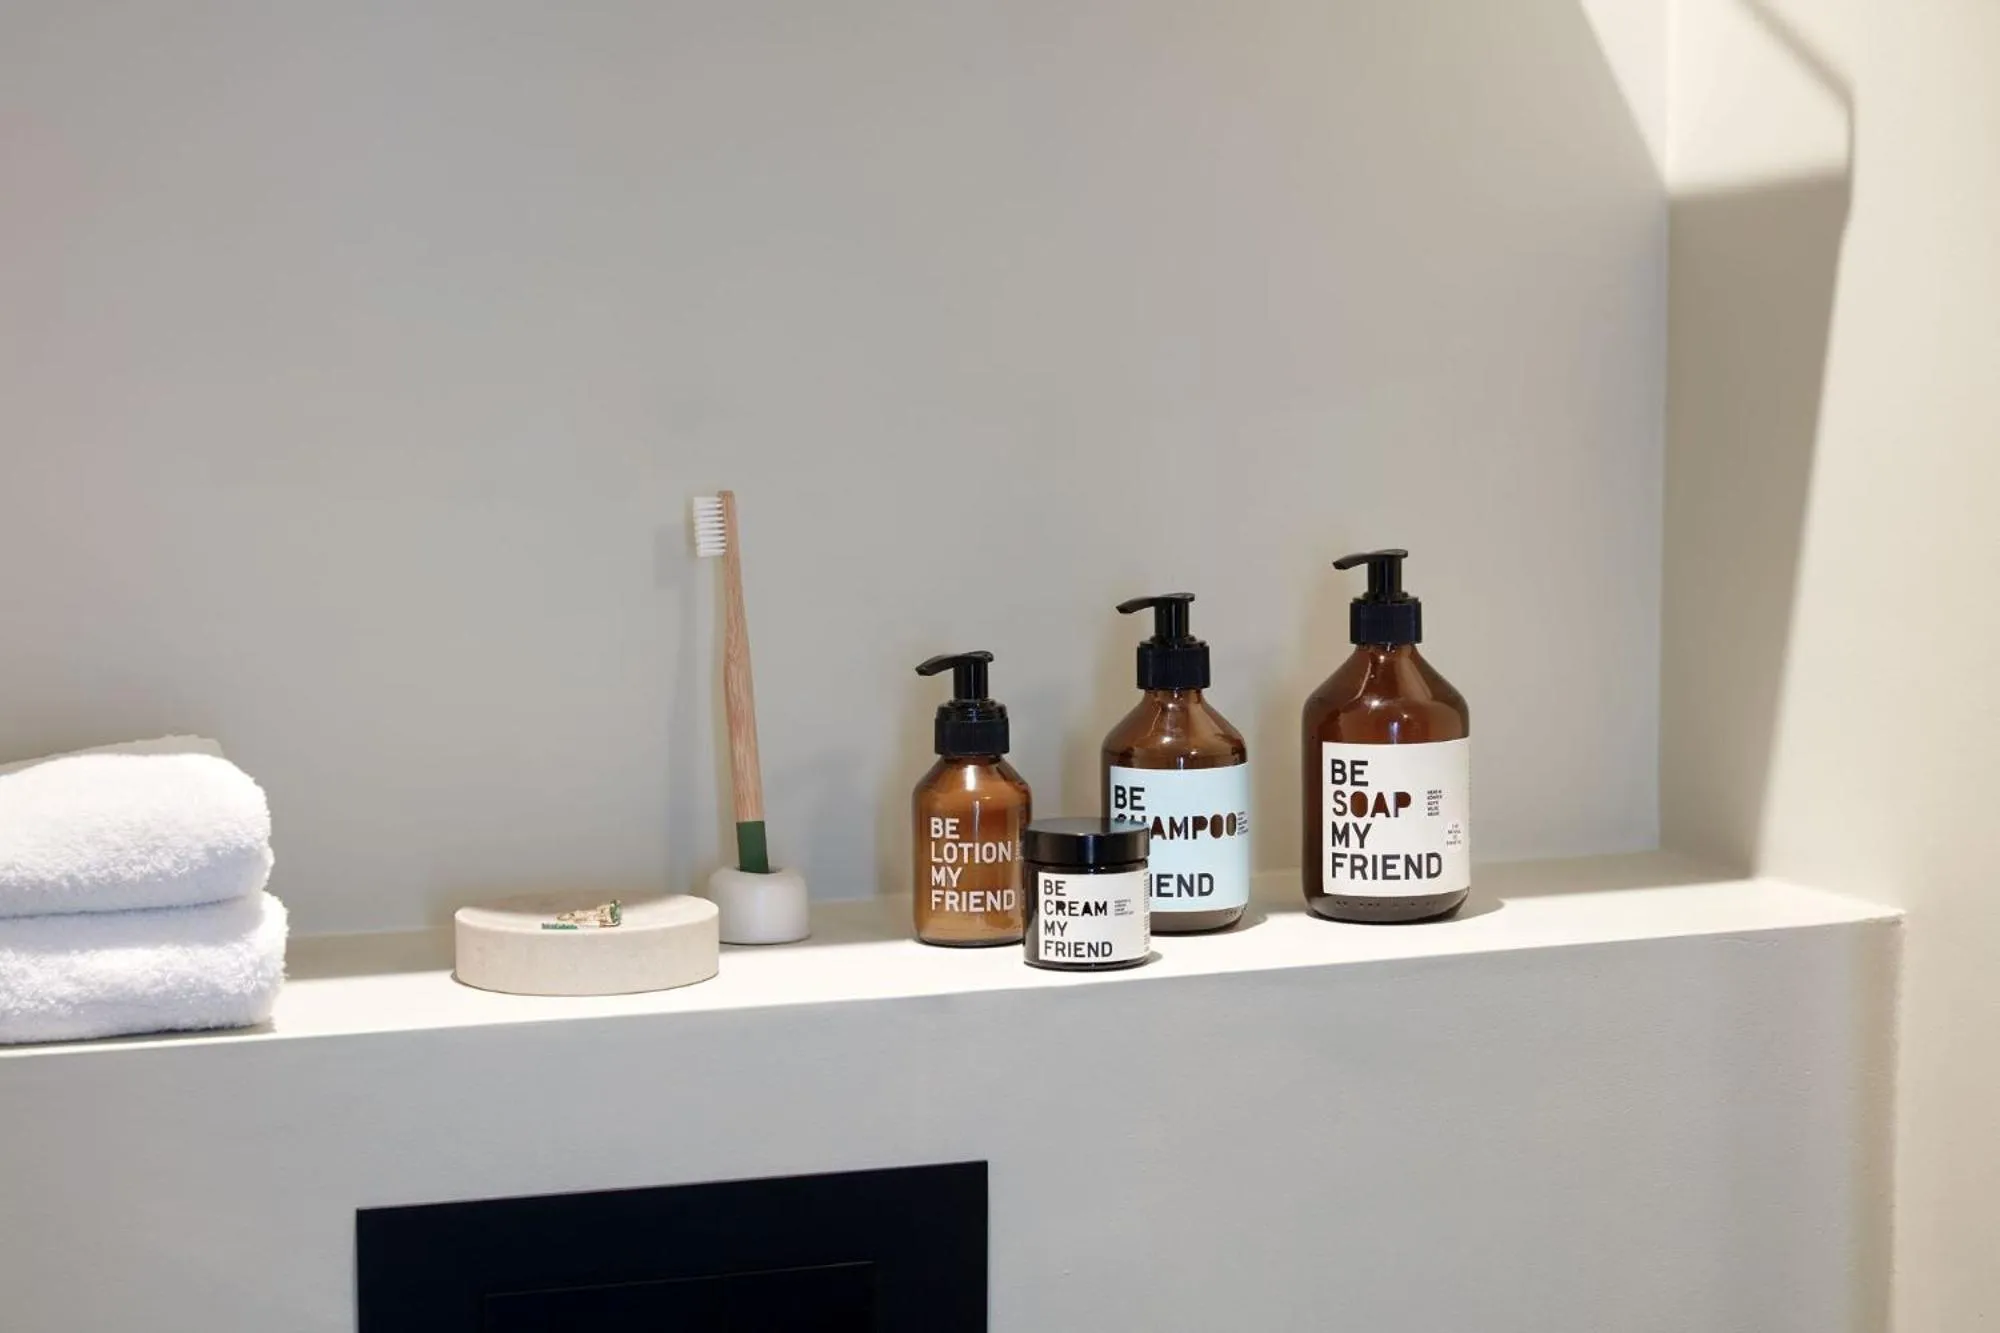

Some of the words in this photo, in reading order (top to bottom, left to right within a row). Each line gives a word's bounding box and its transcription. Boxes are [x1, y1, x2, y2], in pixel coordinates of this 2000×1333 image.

[1331, 758, 1368, 786] BE
[1114, 785, 1145, 811] BE
[1332, 790, 1411, 818] SOAP
[930, 816, 960, 839] BE
[1331, 821, 1372, 849] MY
[931, 840, 1012, 864] LOTION
[931, 865, 962, 888] MY
[1331, 852, 1442, 881] FRIEND
[1043, 879, 1067, 897] BE
[1149, 872, 1215, 898] IEND
[931, 888, 1016, 913] FRIEND
[1044, 899, 1108, 917] CREAM
[1044, 919, 1068, 937] MY
[1044, 939, 1113, 959] FRIEND
